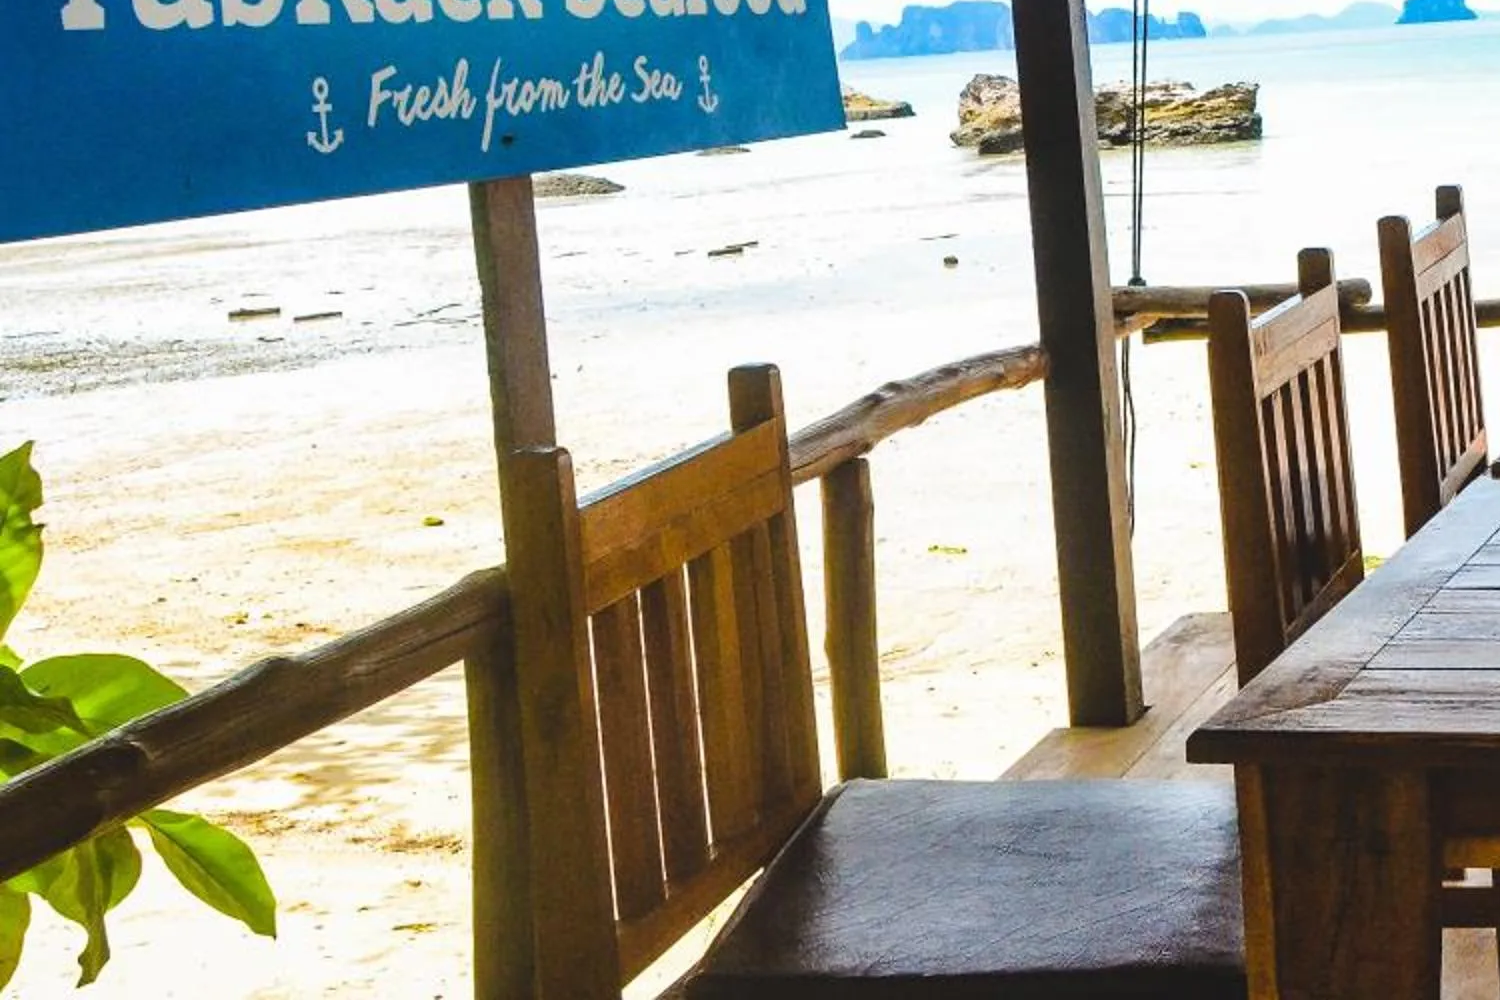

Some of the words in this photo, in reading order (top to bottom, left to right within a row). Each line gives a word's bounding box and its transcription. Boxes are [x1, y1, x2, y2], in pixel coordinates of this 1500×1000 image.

[367, 59, 477, 127] Fresh
[481, 57, 570, 152] from
[572, 51, 625, 107] the
[631, 55, 682, 102] Sea
